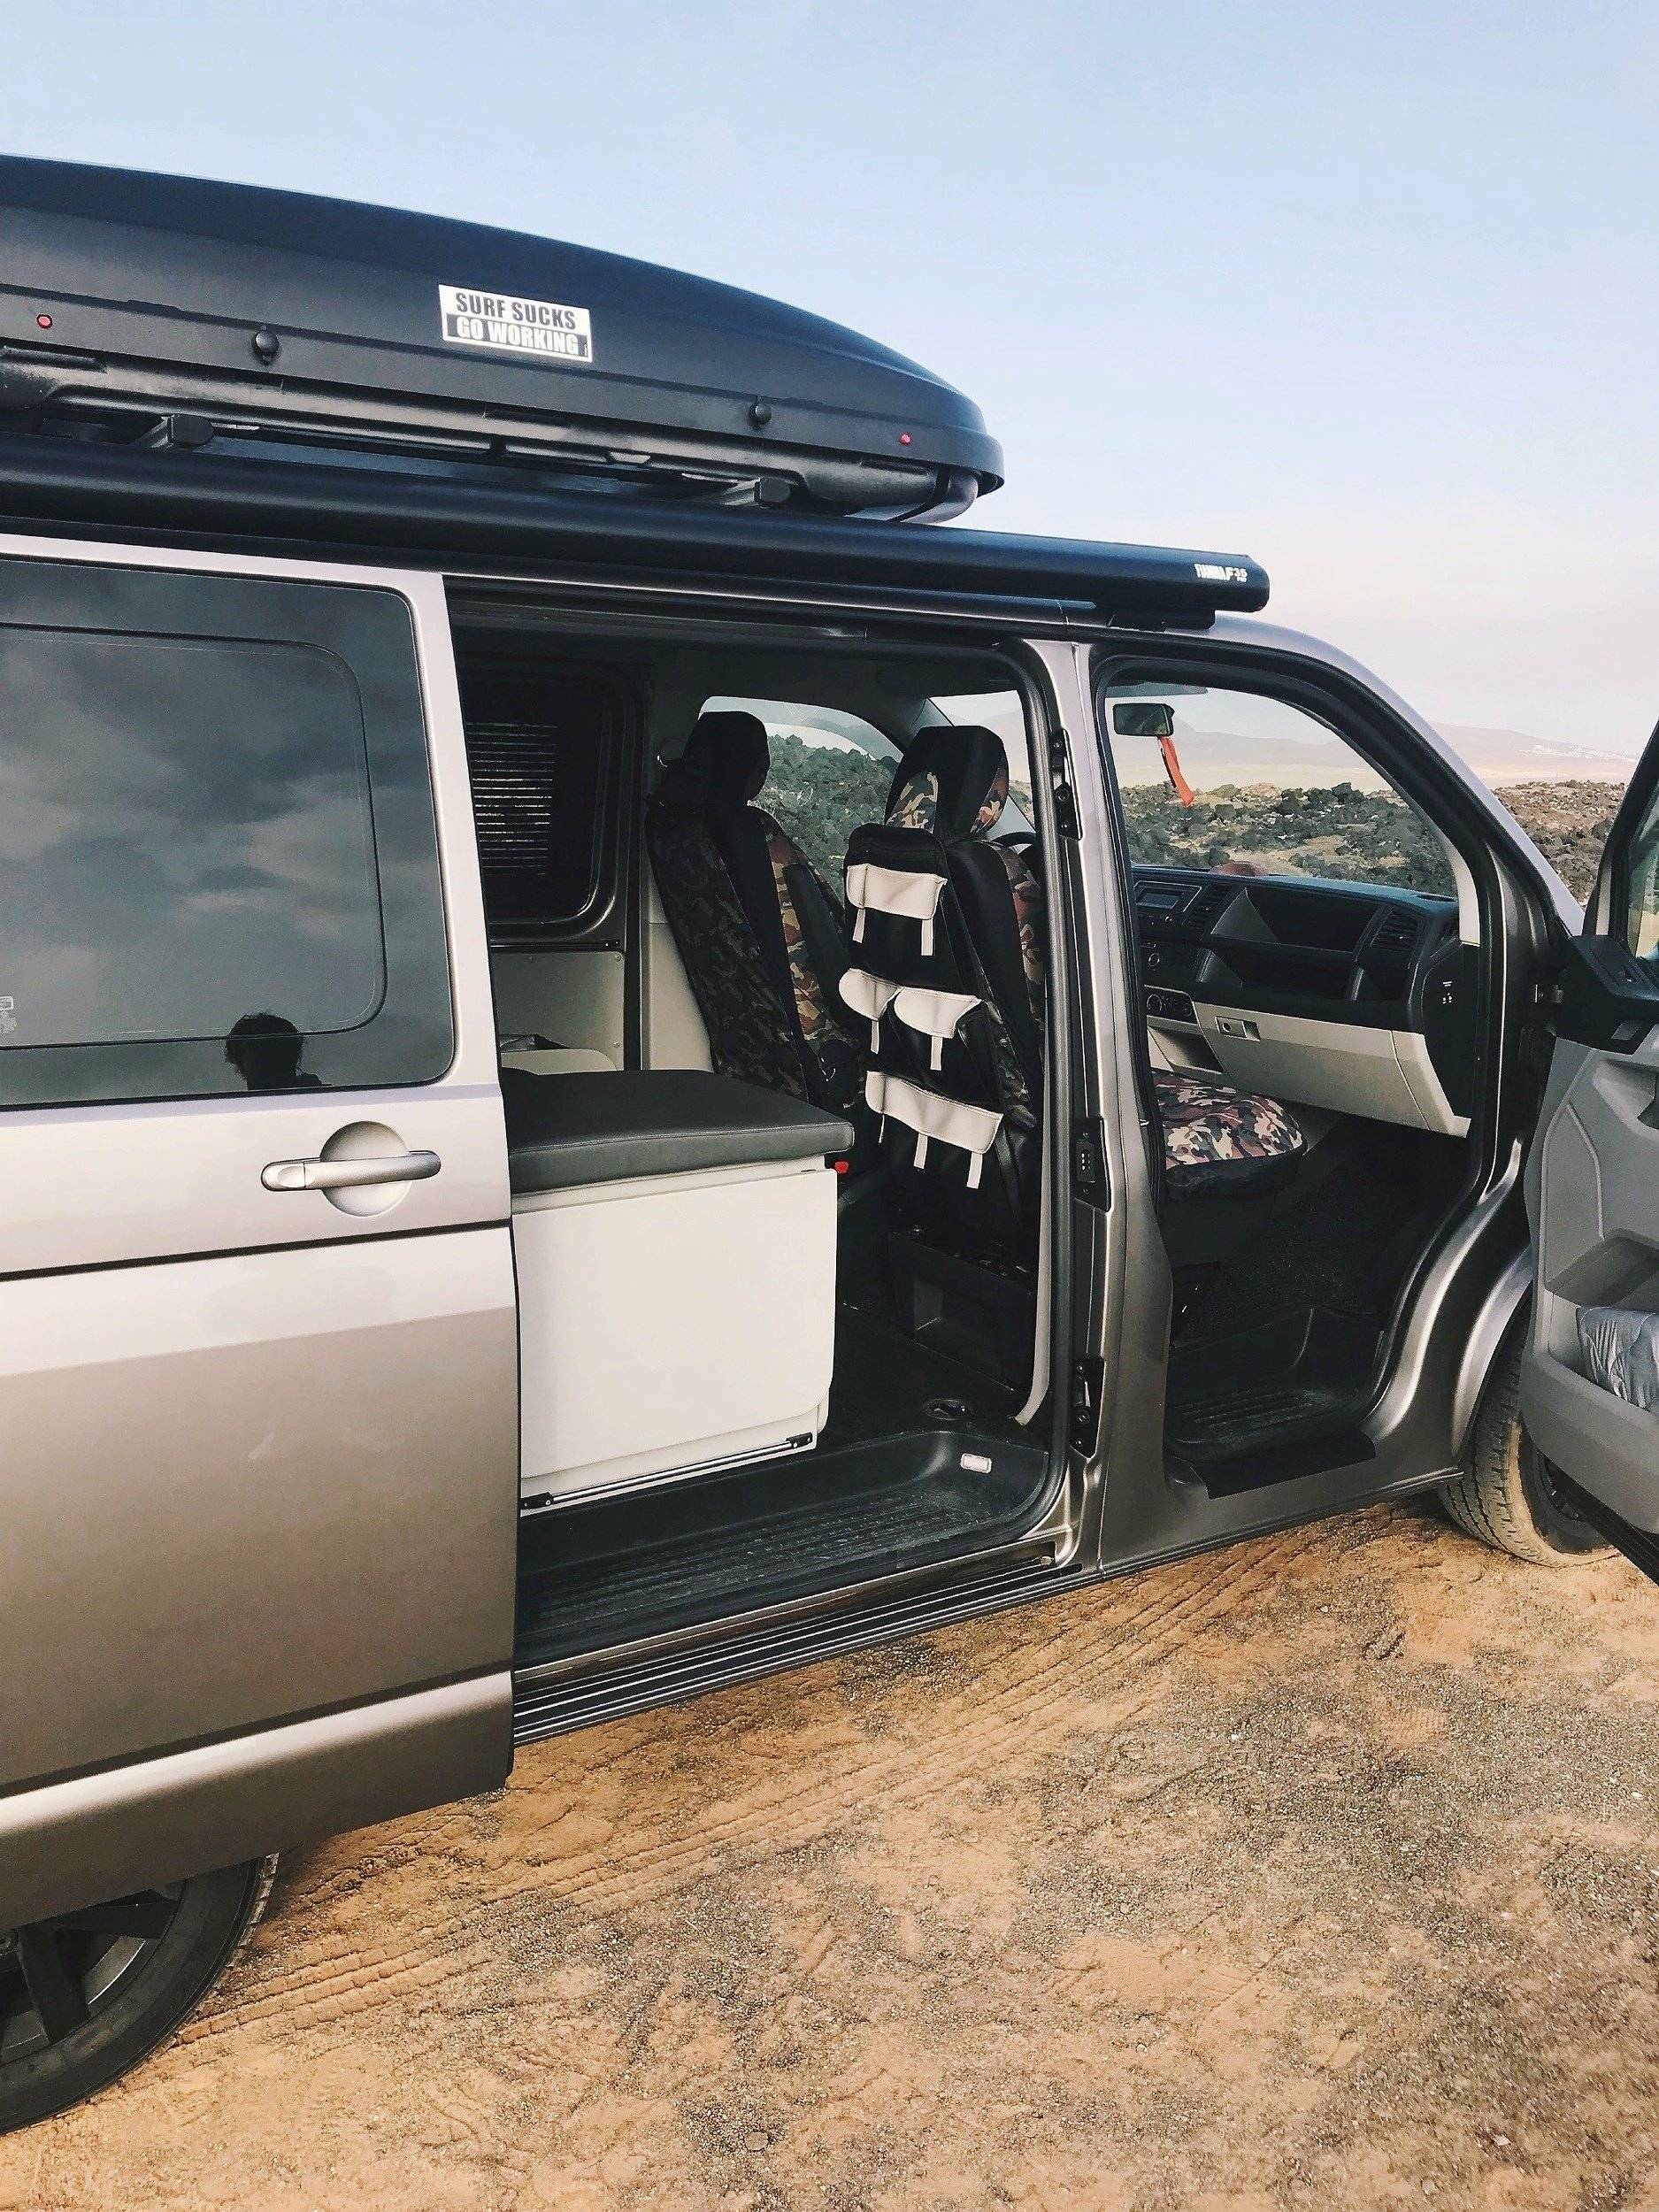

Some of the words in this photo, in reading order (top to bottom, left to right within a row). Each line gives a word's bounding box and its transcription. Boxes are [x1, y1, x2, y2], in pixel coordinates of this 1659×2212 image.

[456, 292, 505, 319] SURF
[511, 302, 576, 330] SUCKS
[456, 316, 484, 340] GO
[488, 321, 579, 355] WORKING
